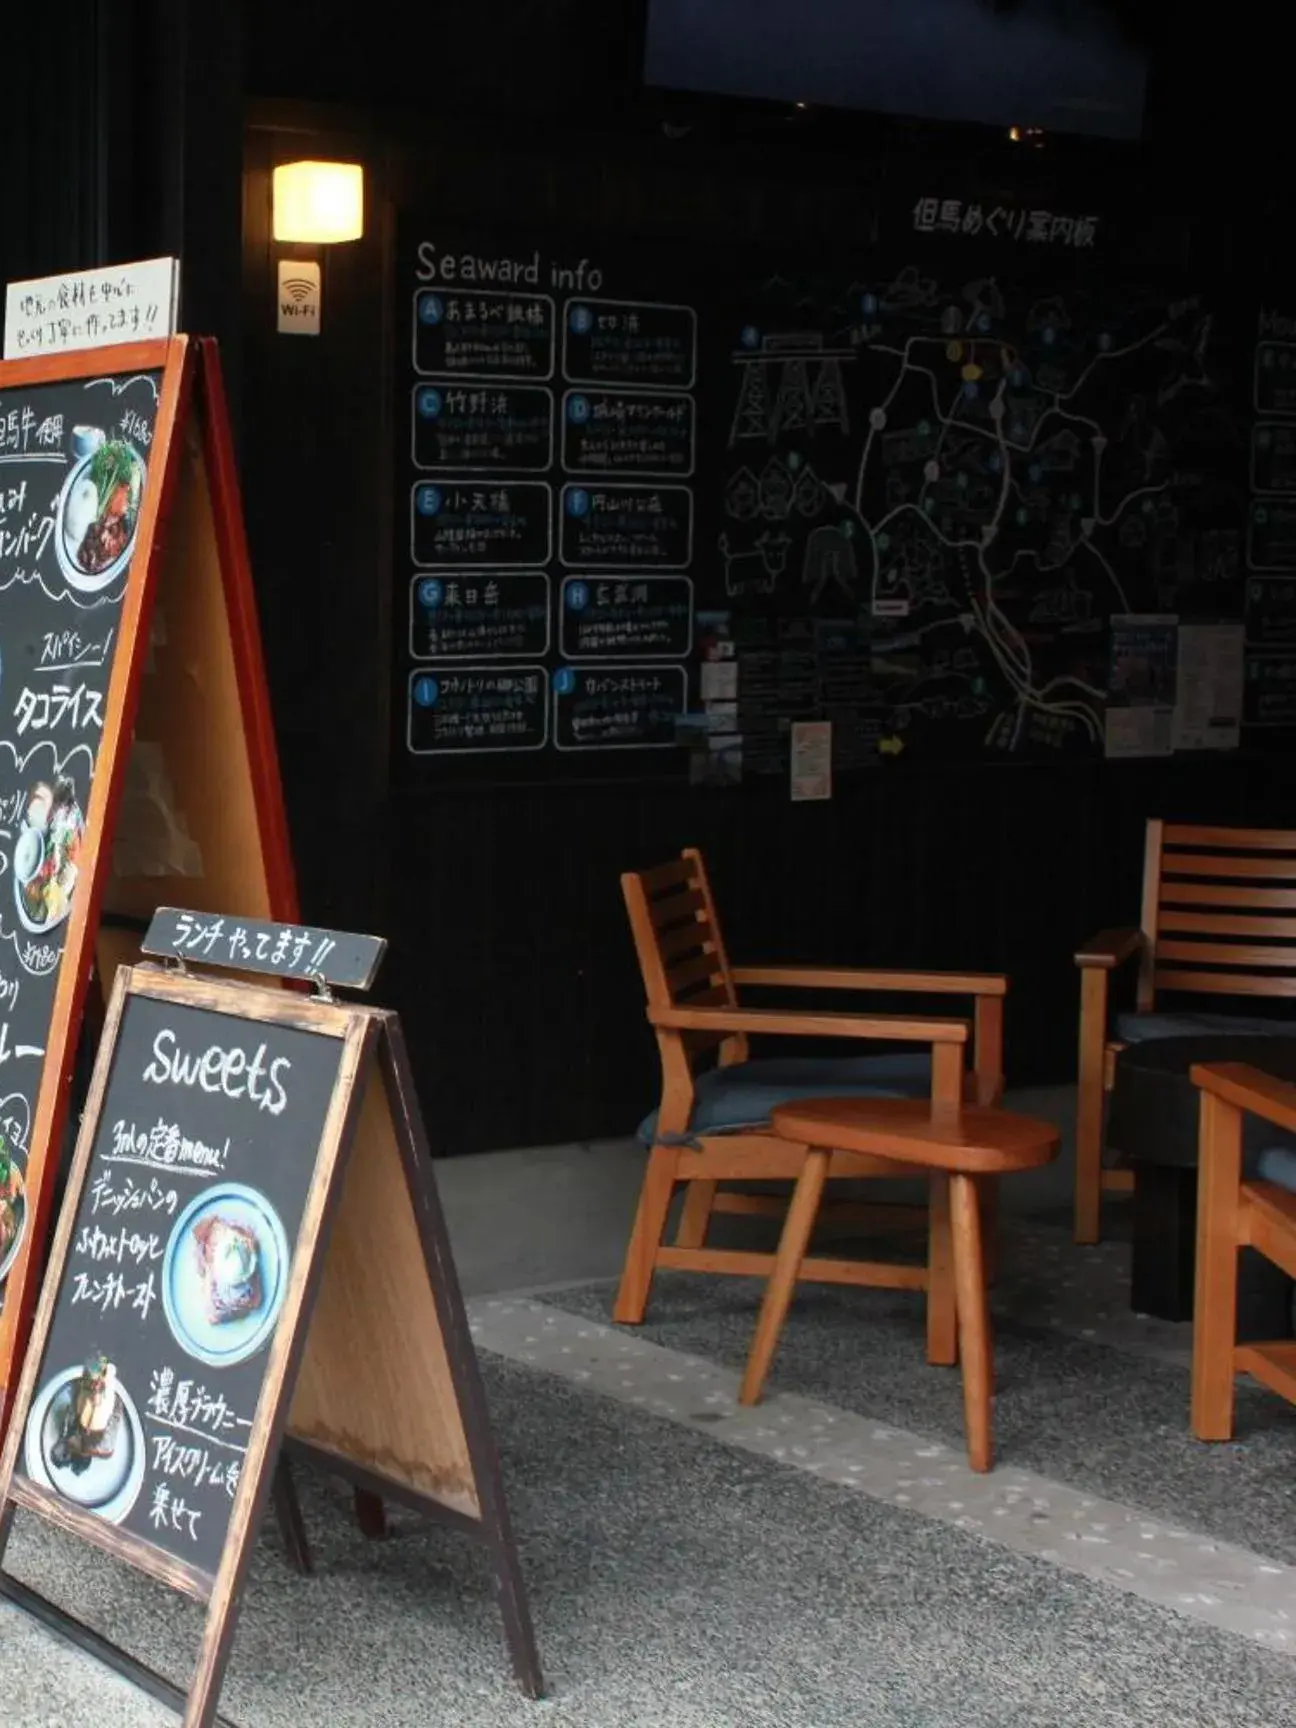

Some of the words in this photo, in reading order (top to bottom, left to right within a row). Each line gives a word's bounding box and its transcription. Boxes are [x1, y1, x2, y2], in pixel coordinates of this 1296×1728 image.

[414, 241, 540, 285] Seaward
[551, 258, 603, 292] info
[281, 303, 316, 318] Wi-Fi
[13, 683, 105, 736] タコライス
[143, 1029, 292, 1116] Sweets
